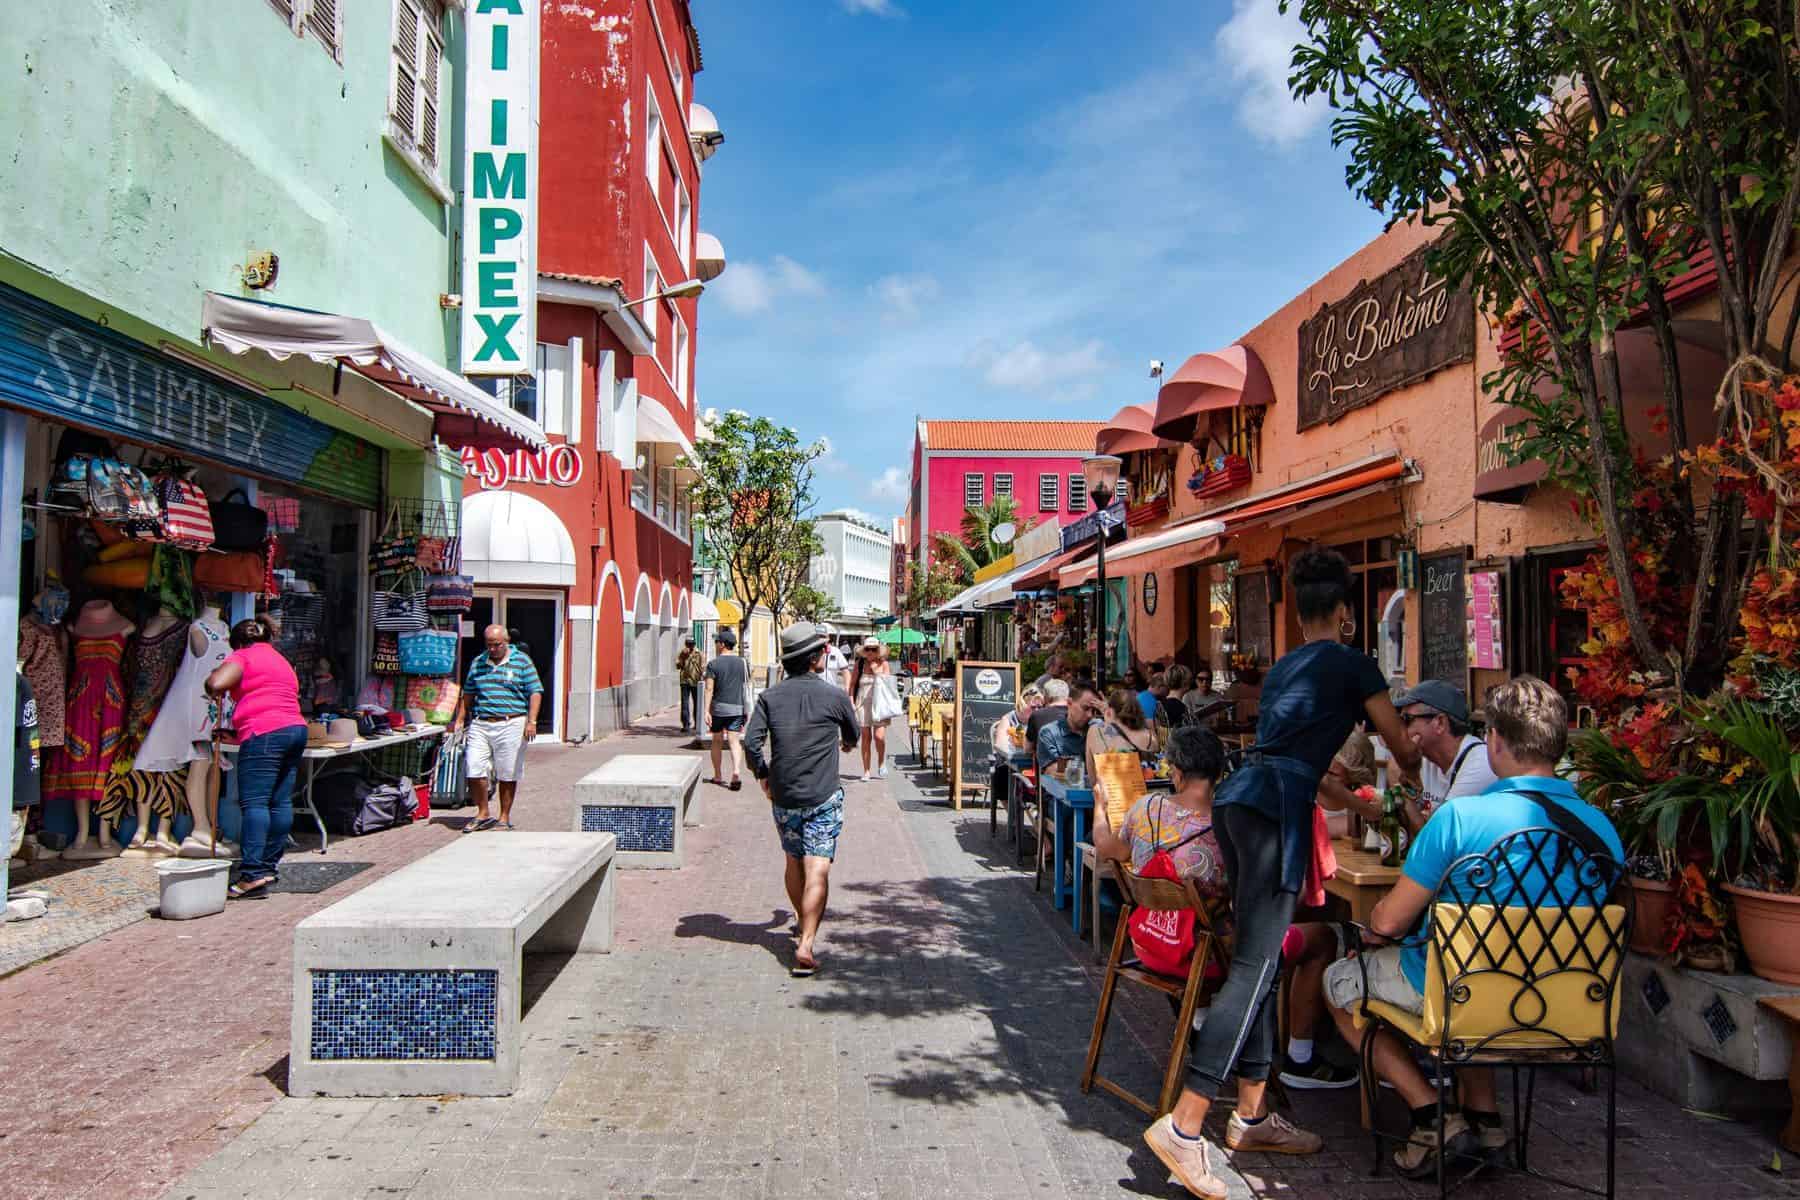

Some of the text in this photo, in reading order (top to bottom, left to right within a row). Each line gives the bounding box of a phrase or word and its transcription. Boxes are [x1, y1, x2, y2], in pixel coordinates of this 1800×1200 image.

[472, 98, 527, 363] IMPEX
[1344, 278, 1450, 368] Bohème
[461, 443, 583, 490] ASINO
[1423, 566, 1457, 595] Beer
